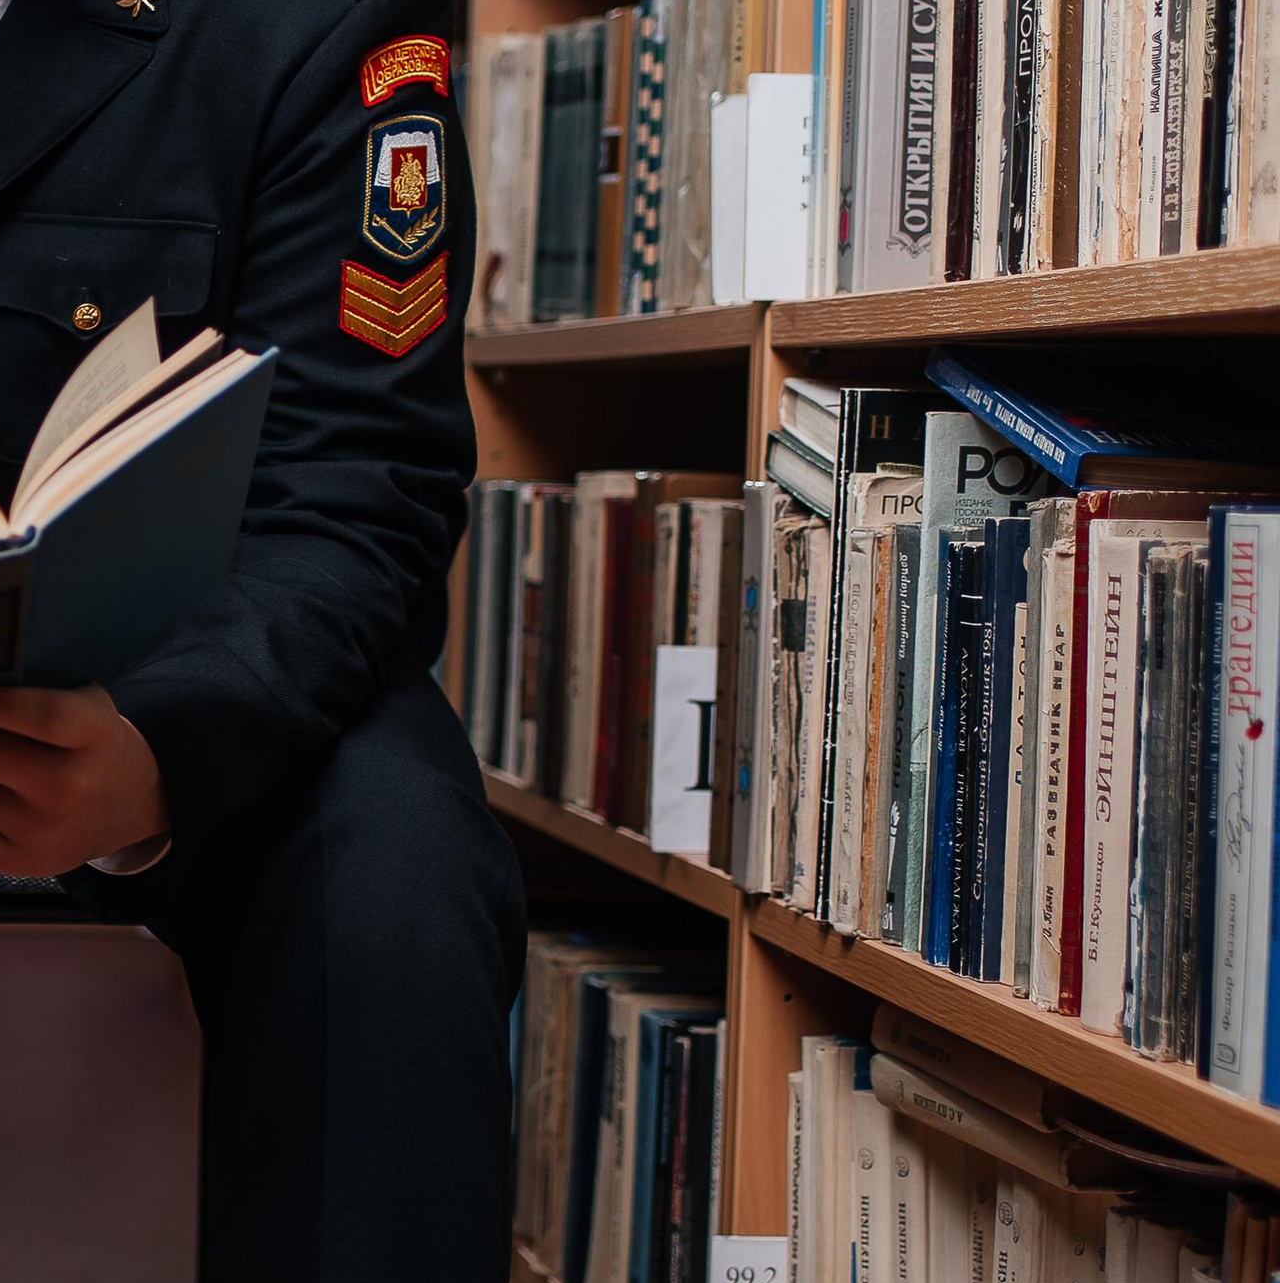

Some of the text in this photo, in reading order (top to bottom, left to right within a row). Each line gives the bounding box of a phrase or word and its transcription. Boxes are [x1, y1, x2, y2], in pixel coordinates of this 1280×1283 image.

[374, 59, 445, 85] ОБРАЗОВАНИЕ
[378, 45, 439, 68] КАДЕТСКОЕ
[910, 39, 935, 63] И
[1148, 28, 1165, 114] КАПИЦА
[902, 65, 936, 235] ОТКРЫТИЯ
[1051, 623, 1065, 692] НЕДР
[1211, 600, 1225, 666] ПРАВДЫ
[1223, 540, 1259, 718] трагедии
[891, 552, 910, 789] НЬЮТОН Владимир Карцев
[1094, 573, 1123, 825] ЭЙНШТЕЙН
[1210, 672, 1222, 746] ПОИСКАХ
[972, 621, 994, 902] Сахаровский сборник 1981
[1045, 701, 1061, 858] РАЗВЕДЧИК
[950, 856, 963, 945] НАДЕЖДА
[1220, 975, 1235, 1032] Федор
[792, 1134, 802, 1212] НАРОДОВ
[861, 1194, 871, 1271] ПУШКИН
[898, 1202, 909, 1280] ПУШКИН
